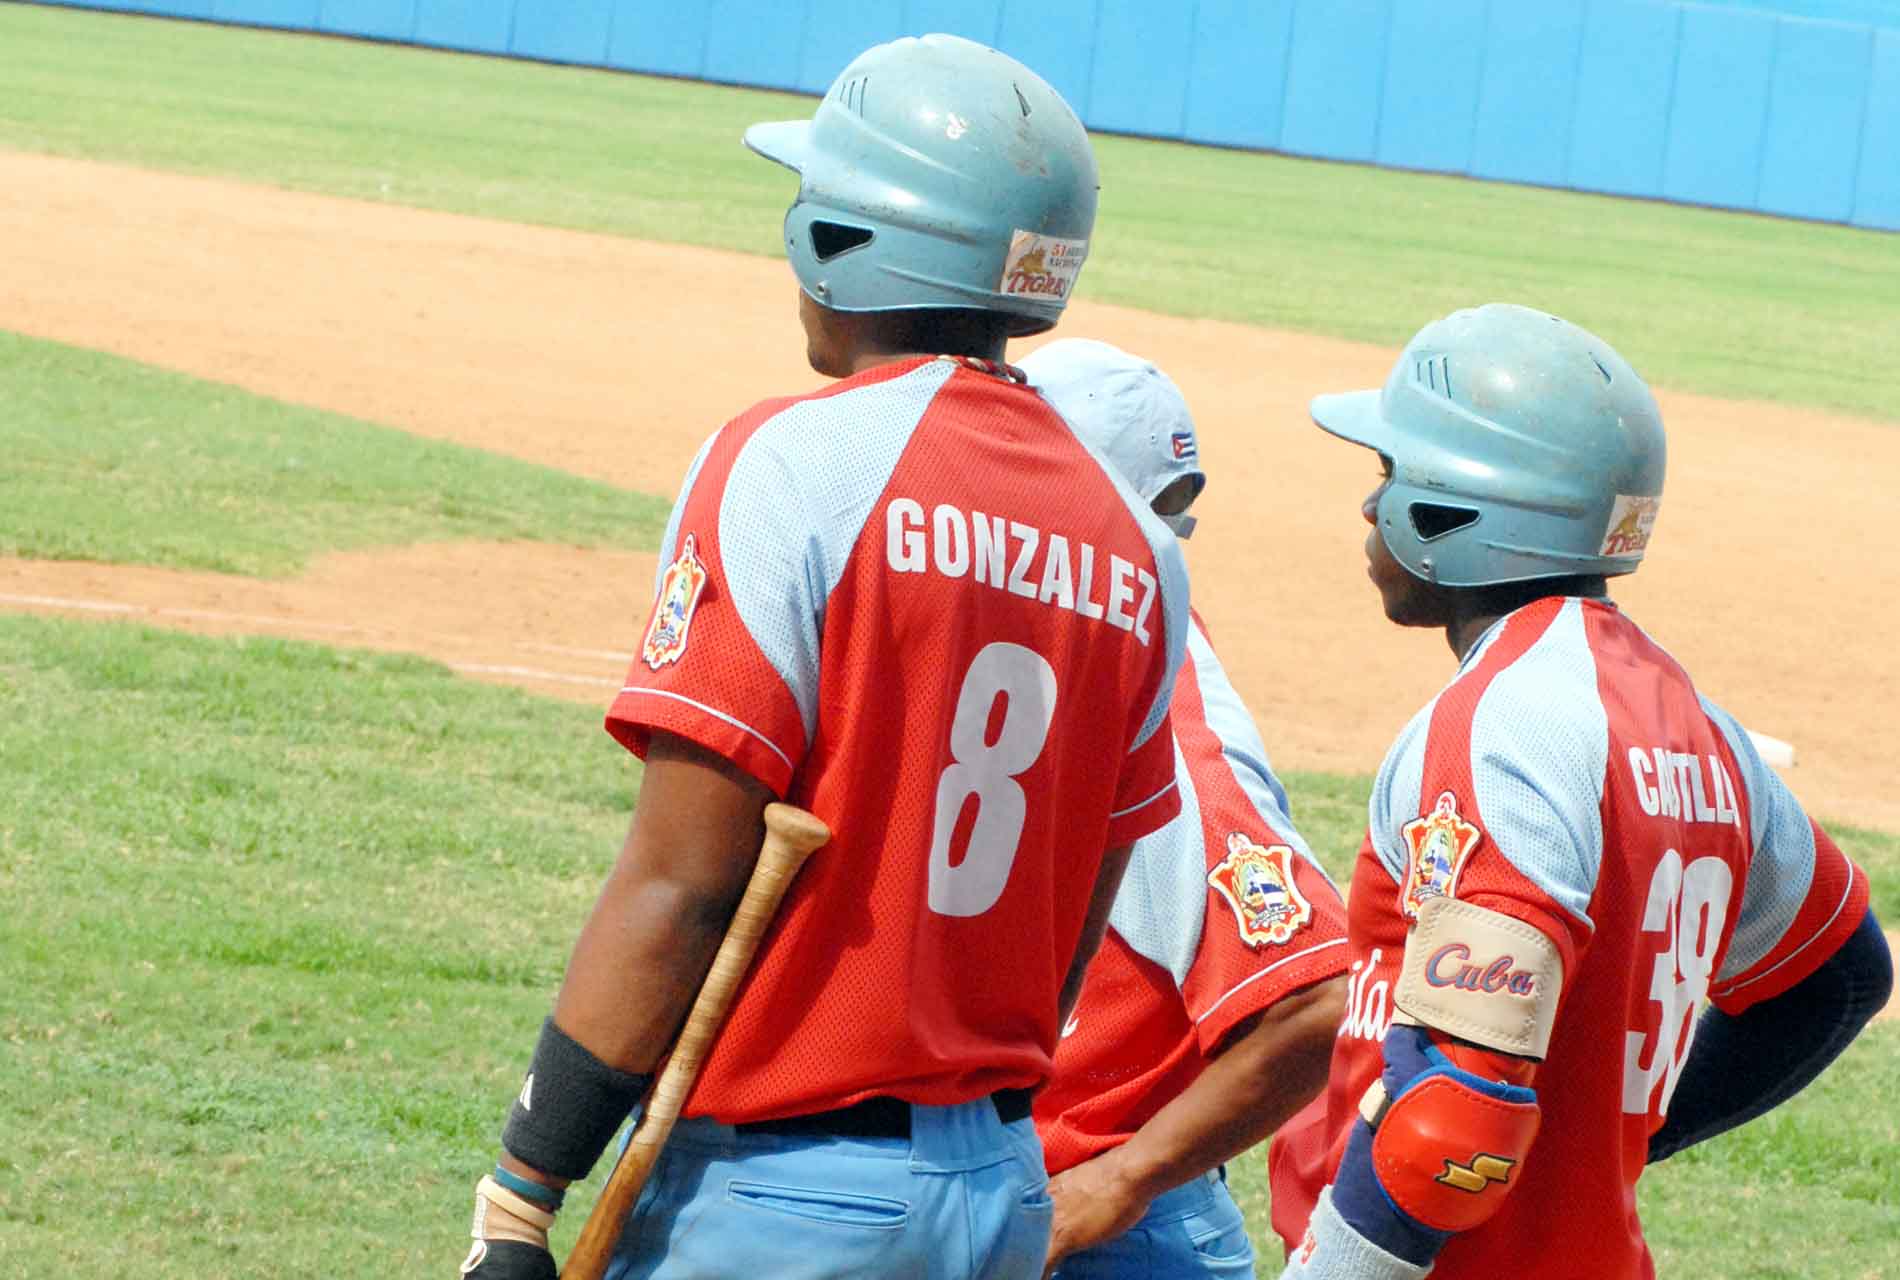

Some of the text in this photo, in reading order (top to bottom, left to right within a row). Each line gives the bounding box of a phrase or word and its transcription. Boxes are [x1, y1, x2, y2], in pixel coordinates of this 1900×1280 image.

[886, 497, 1157, 647] GONZALEZ
[927, 641, 1058, 918] 8
[1425, 943, 1535, 996] Cuba
[1622, 847, 1734, 1117] 38
